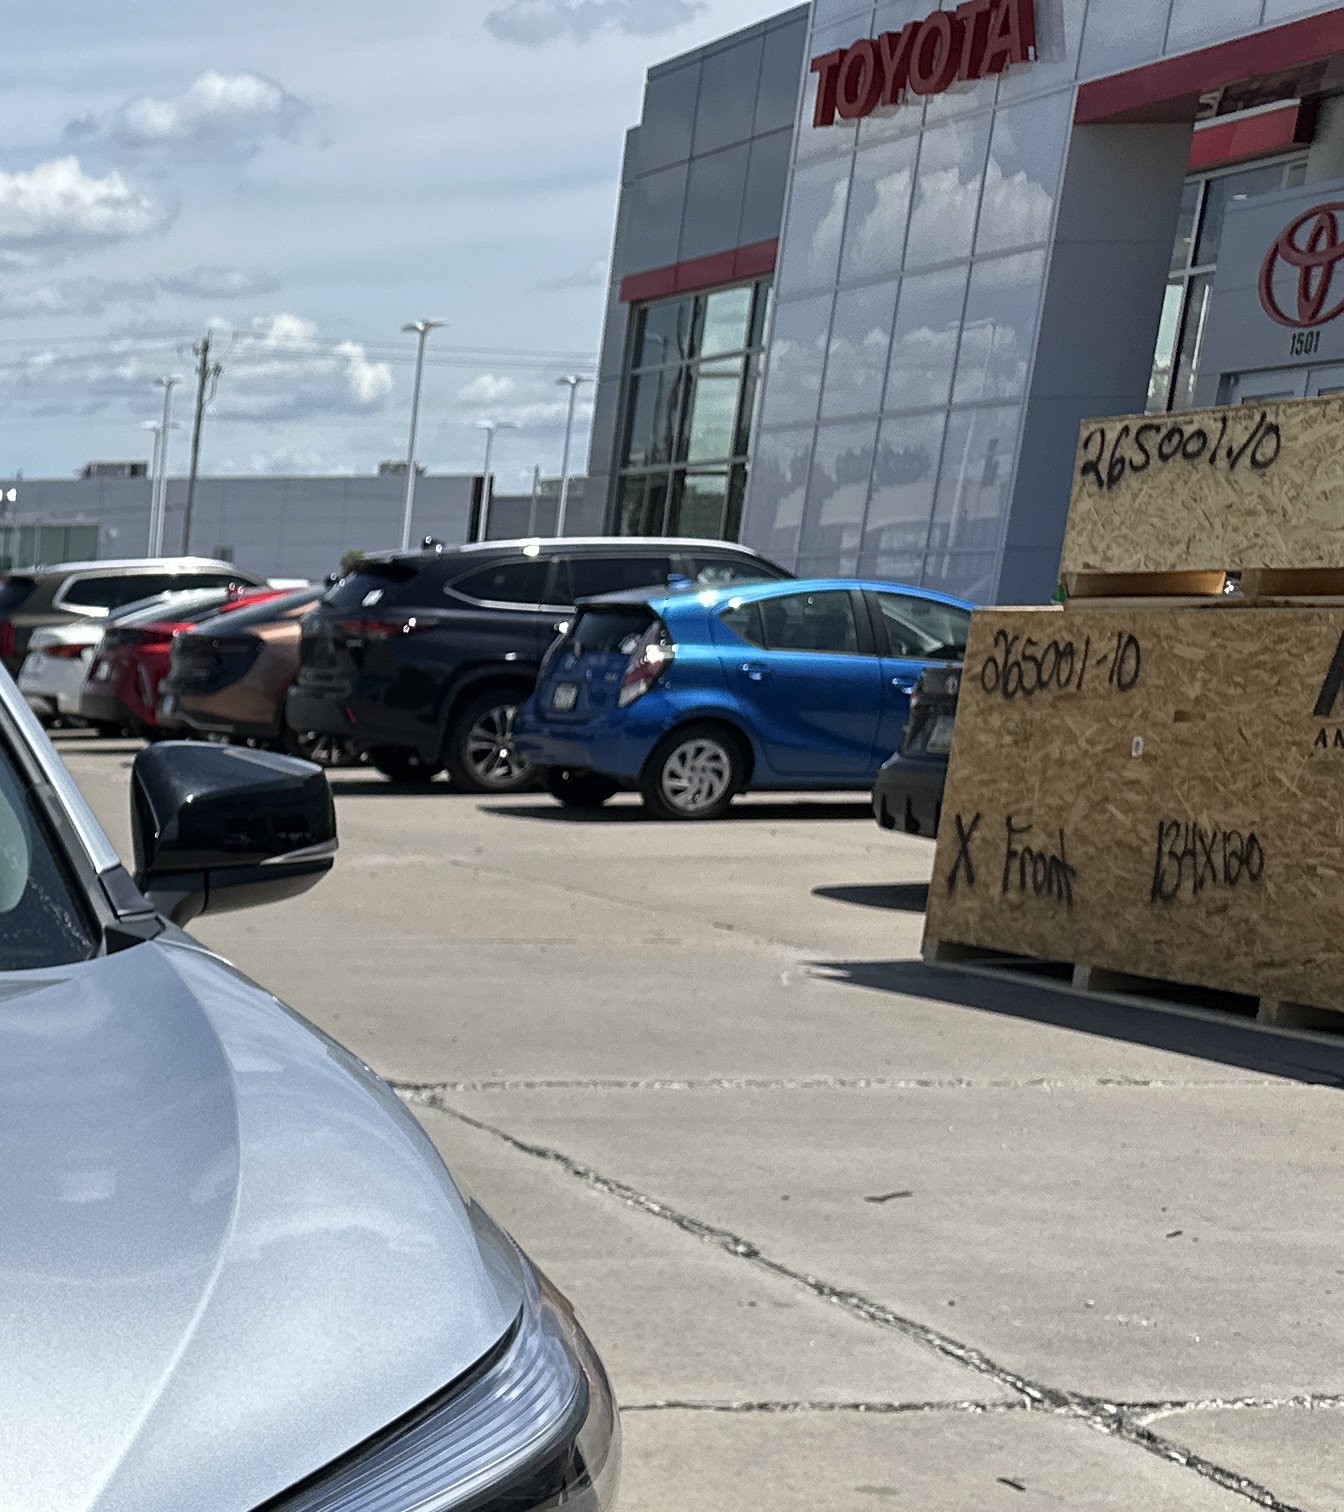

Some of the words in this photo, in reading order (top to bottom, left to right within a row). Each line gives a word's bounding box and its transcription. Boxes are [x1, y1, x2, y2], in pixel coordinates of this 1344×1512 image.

[810, 0, 1037, 128] TOYOTA
[1289, 329, 1321, 355] 1501
[947, 812, 983, 896] X
[1002, 814, 1077, 905] Front
